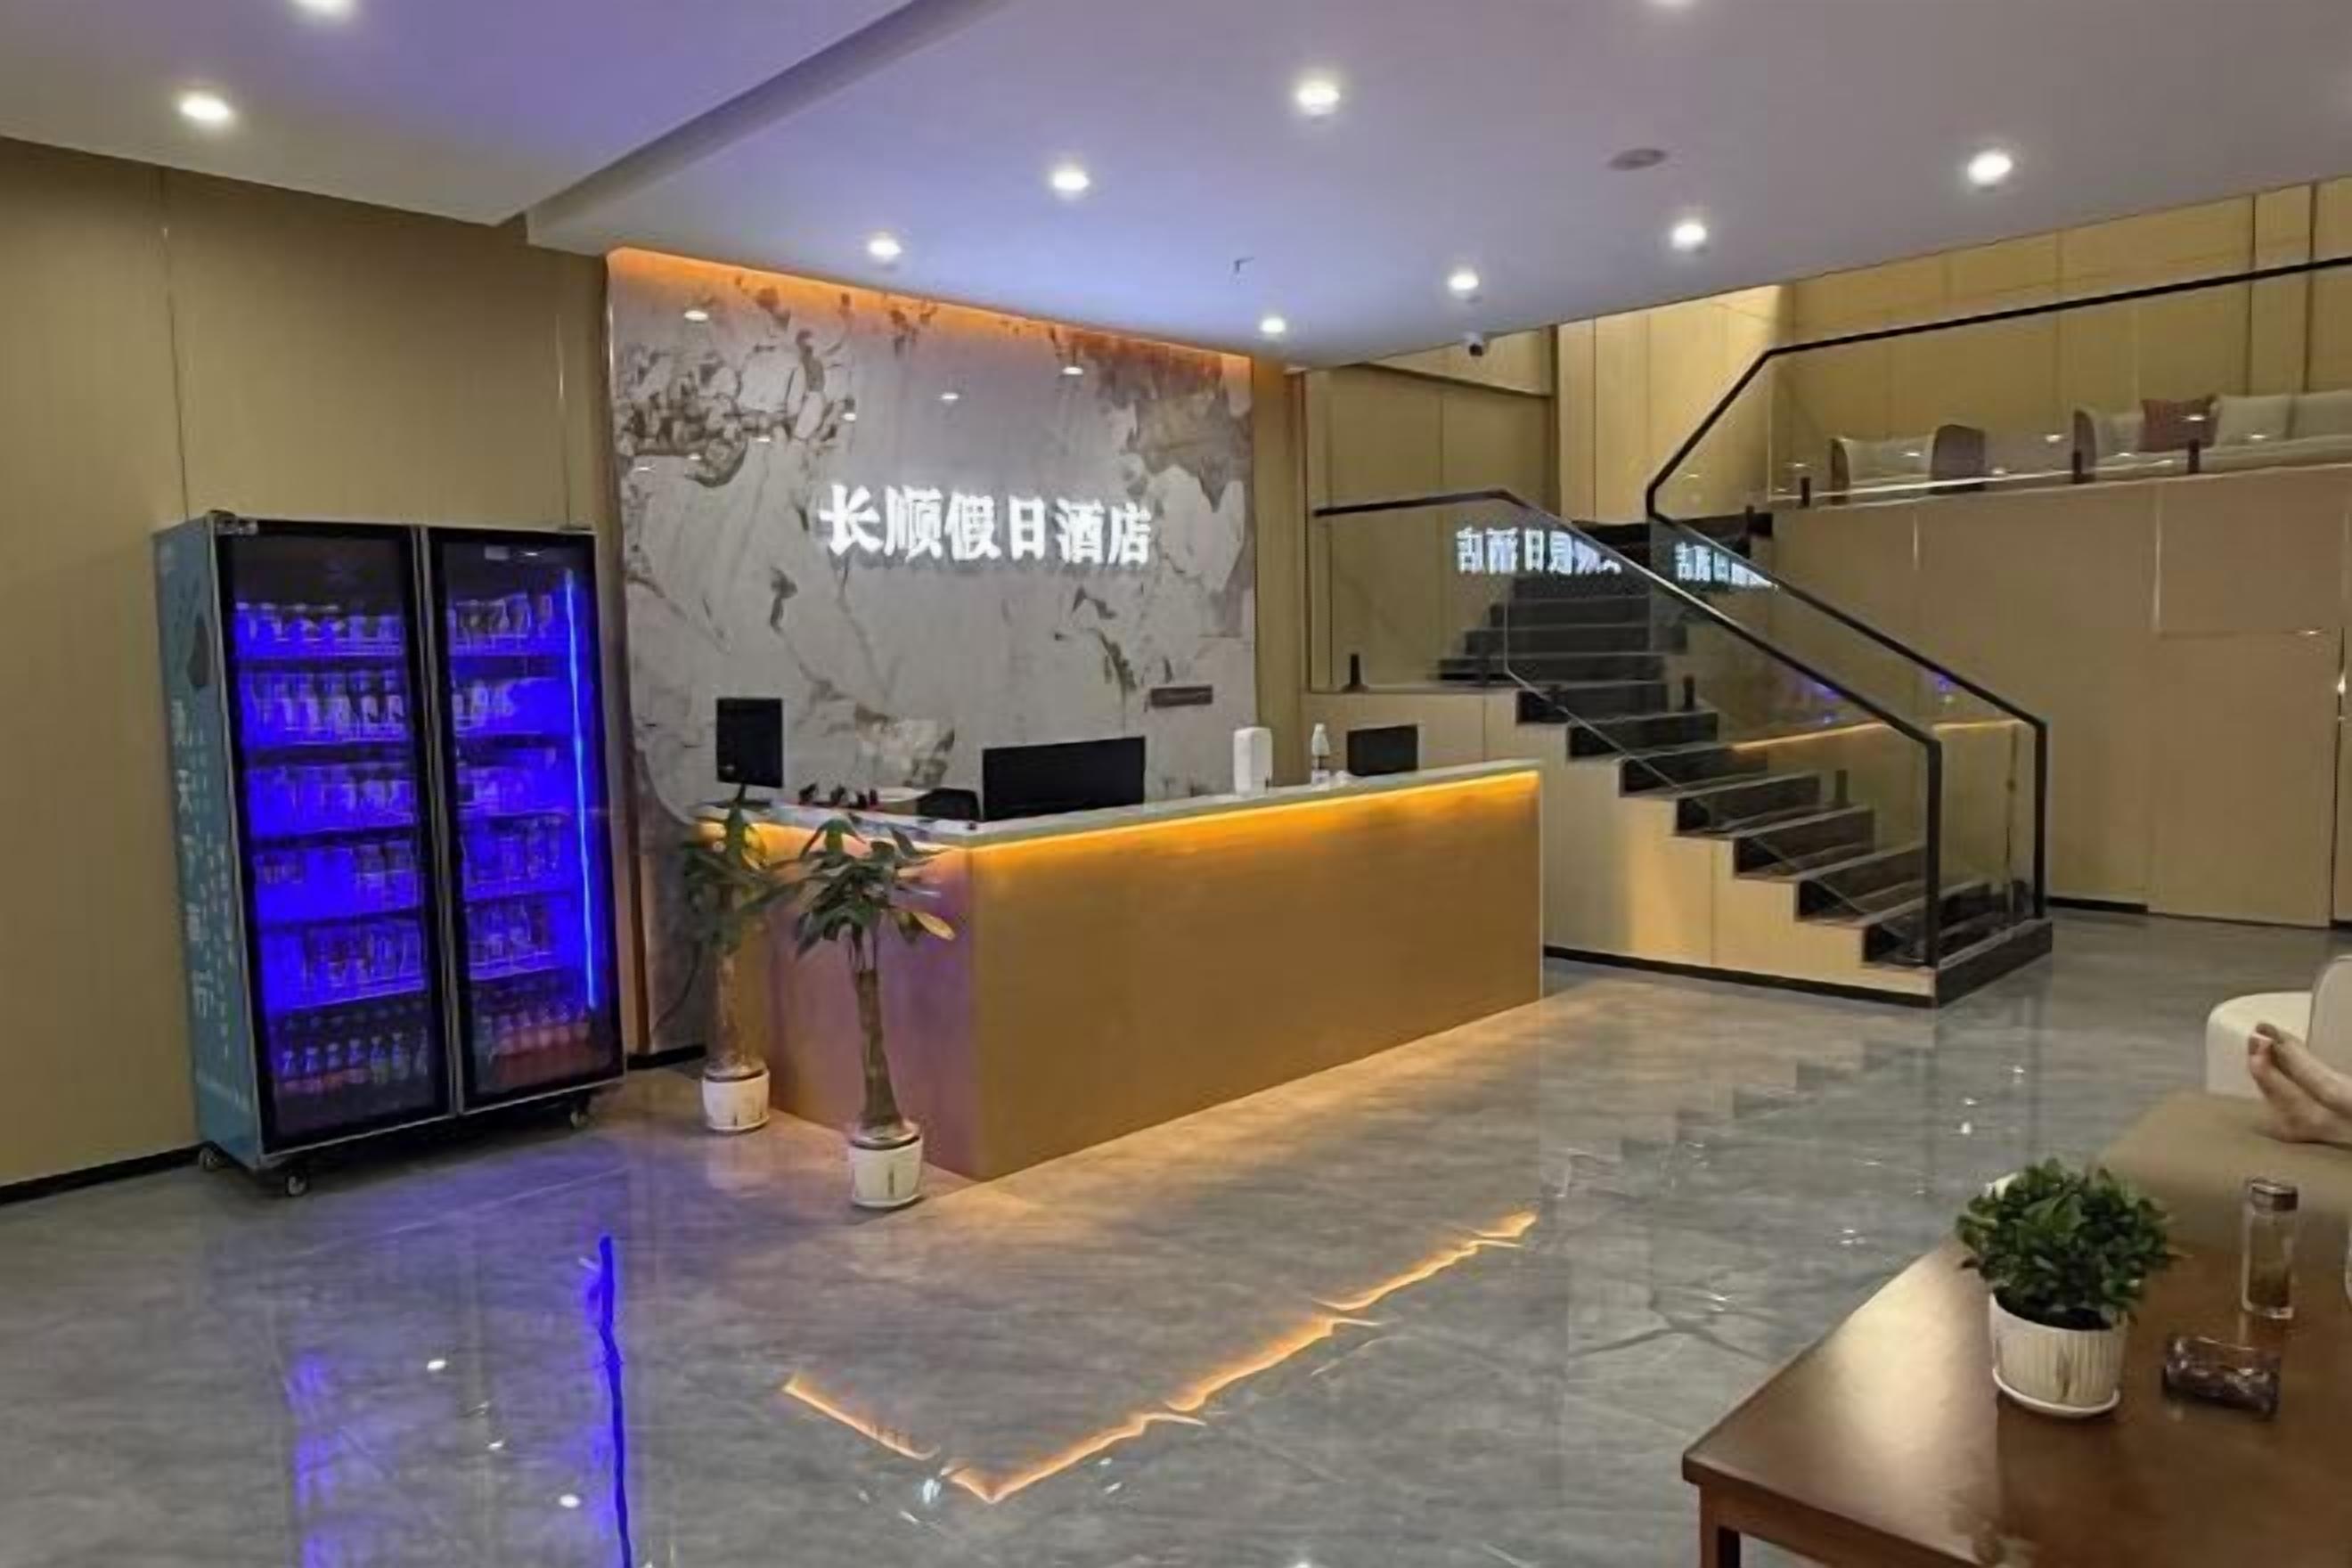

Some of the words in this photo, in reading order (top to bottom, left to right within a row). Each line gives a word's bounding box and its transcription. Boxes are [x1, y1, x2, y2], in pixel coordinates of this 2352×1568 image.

[818, 484, 1151, 564] 长顺假日酒店
